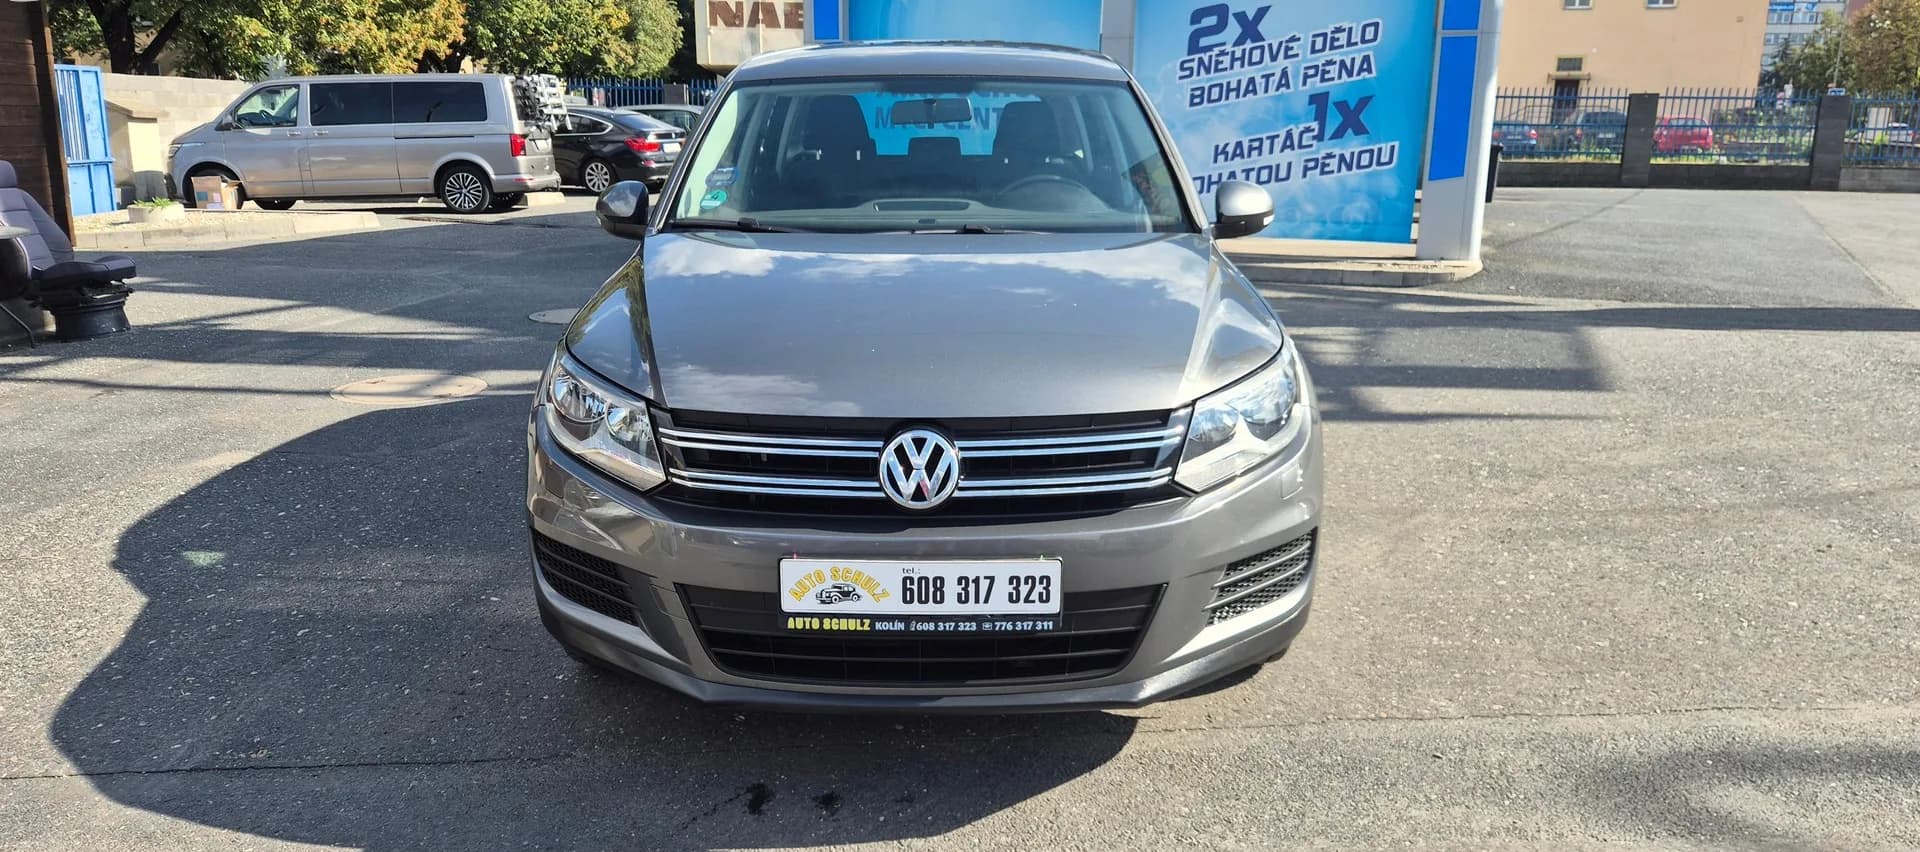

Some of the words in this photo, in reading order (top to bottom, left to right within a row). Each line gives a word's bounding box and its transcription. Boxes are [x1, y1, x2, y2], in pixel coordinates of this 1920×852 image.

[1178, 35, 1301, 80] SNĚHOVÉ
[1310, 21, 1380, 55] DĚLO
[1187, 3, 1272, 56] 2x
[1189, 66, 1291, 107] BOHATÁ
[1301, 54, 1374, 87] PĚNA
[1308, 91, 1376, 143] 1x
[1213, 126, 1316, 164] KARTÁČ
[1192, 161, 1292, 194] OHATOU
[1301, 144, 1396, 179] PĚNOU
[788, 569, 826, 602] AUTO
[830, 566, 891, 603] SCHULZ
[902, 567, 921, 575] tel.:
[902, 576, 945, 604] 608
[957, 576, 996, 604] 317
[1008, 575, 1051, 604] 323
[787, 617, 820, 630] AUTO
[823, 618, 871, 631] SCHULZ
[875, 620, 905, 631] KOLÍN
[916, 622, 935, 631] 608
[937, 622, 955, 631] 317
[957, 622, 977, 631] 323
[994, 622, 1013, 631] 776
[1015, 622, 1033, 631] 317
[1035, 621, 1053, 630] 311
